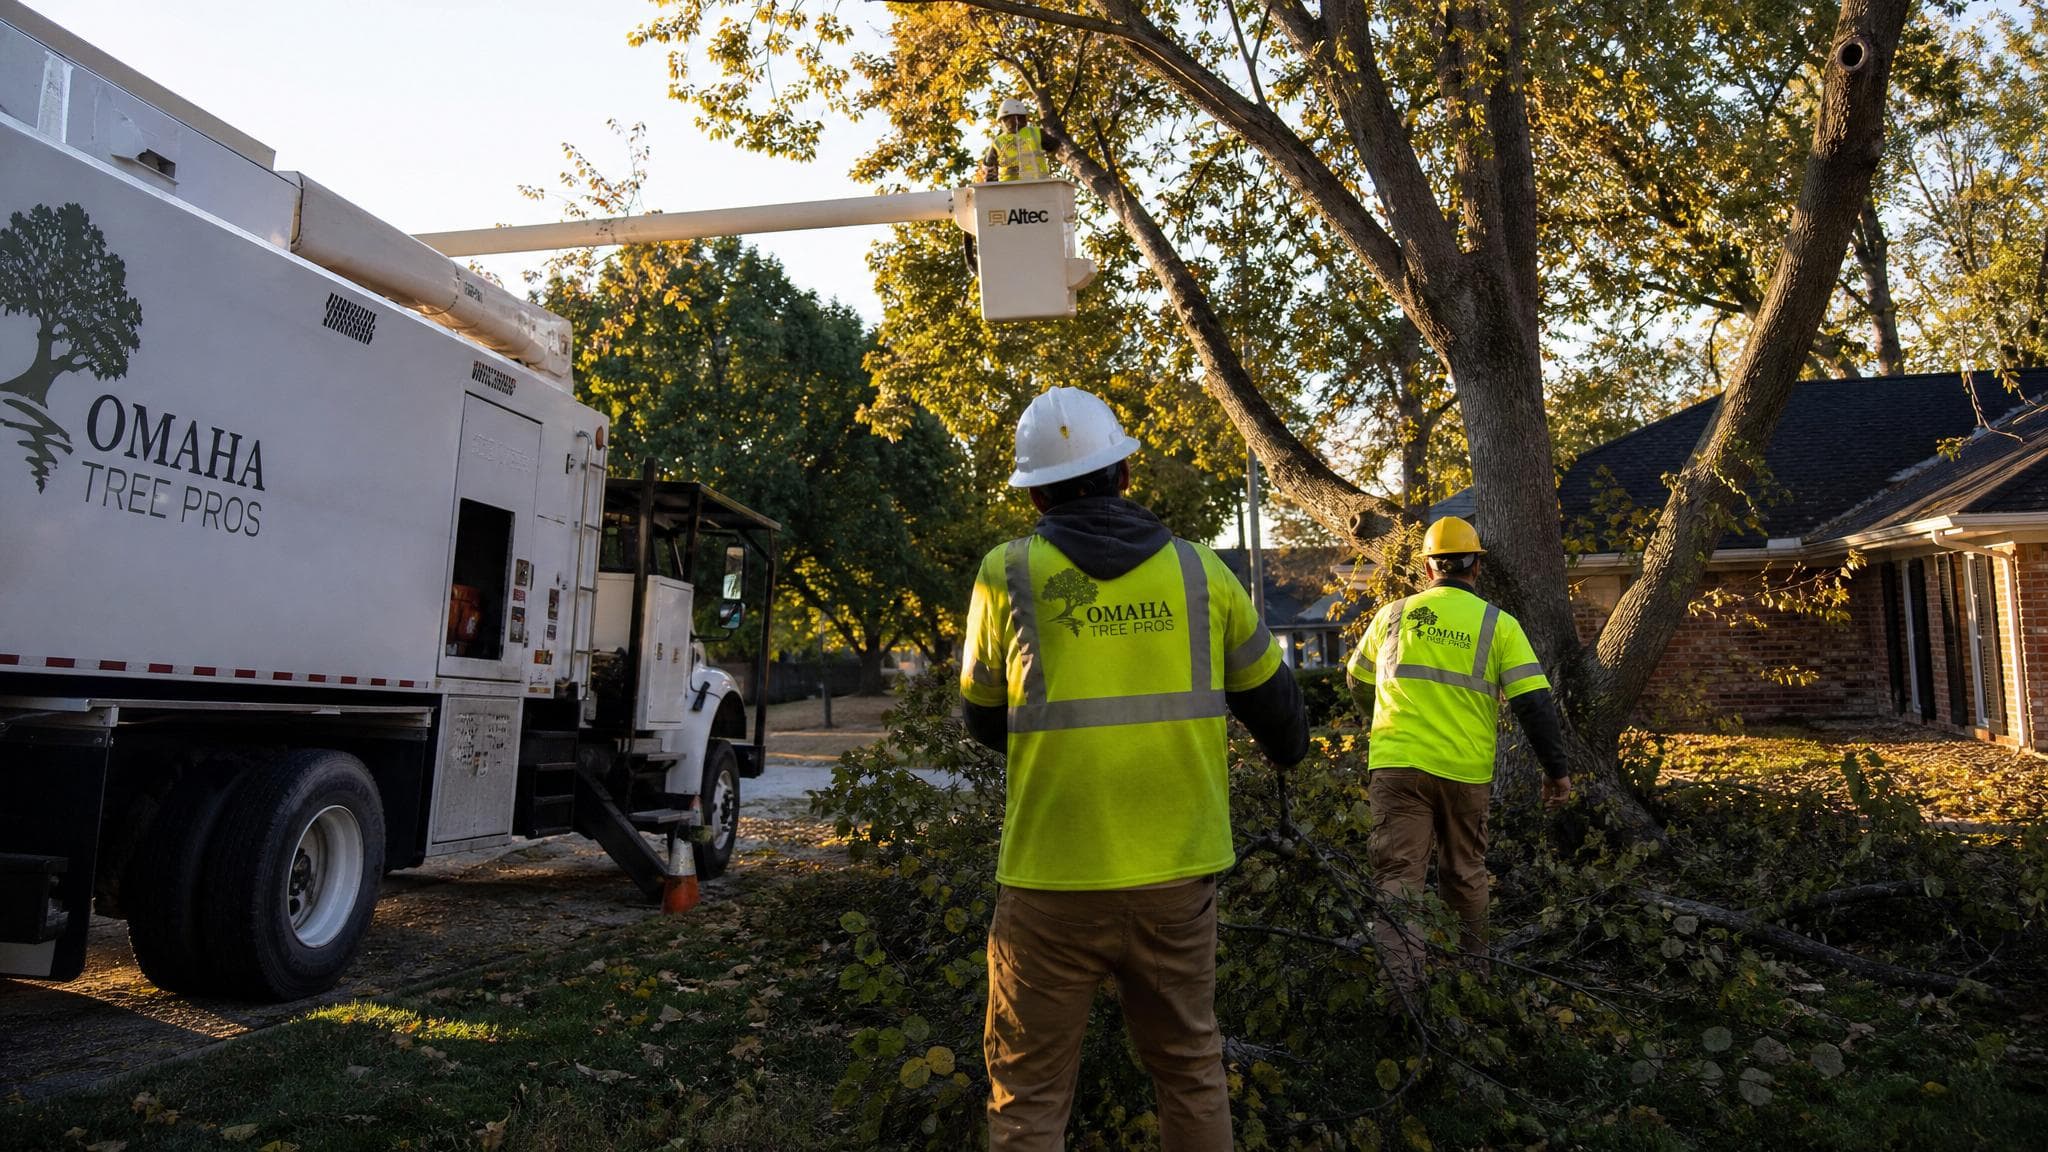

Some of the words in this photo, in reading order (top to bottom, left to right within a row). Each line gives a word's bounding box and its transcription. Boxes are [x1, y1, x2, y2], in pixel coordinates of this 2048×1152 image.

[1008, 208, 1049, 225] Altec
[87, 394, 265, 491] OMAHA
[82, 460, 171, 519] TREE
[181, 485, 262, 537] PROS
[1086, 600, 1173, 624] OMAHA
[1089, 622, 1128, 637] TREE
[1133, 619, 1175, 634] PROS
[1427, 626, 1472, 643] OMAHA
